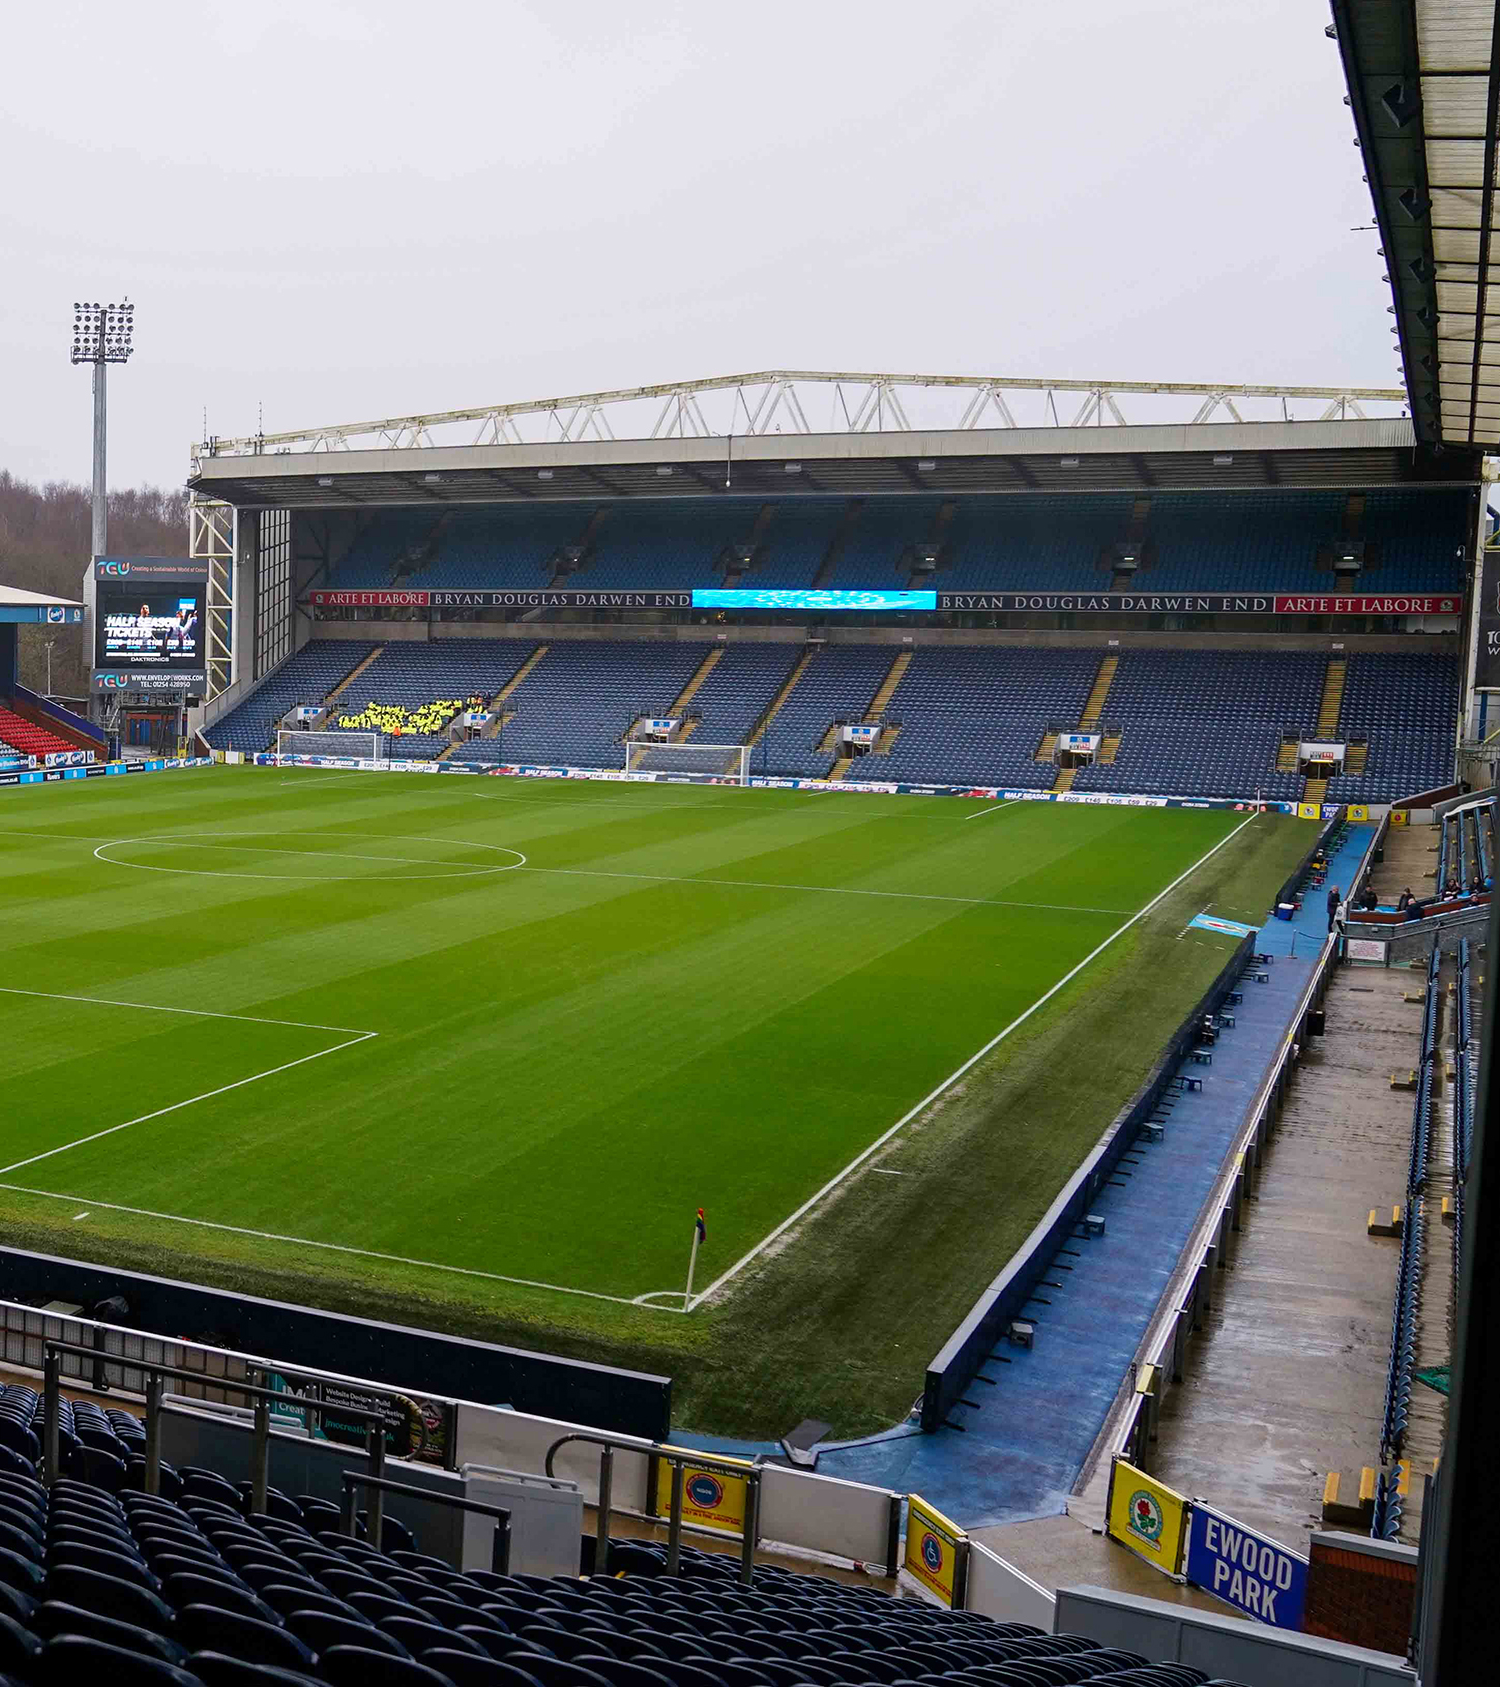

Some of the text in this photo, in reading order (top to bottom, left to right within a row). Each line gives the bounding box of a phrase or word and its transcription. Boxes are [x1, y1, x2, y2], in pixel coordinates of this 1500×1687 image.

[329, 592, 425, 605] ARTE ET LABORE
[435, 594, 690, 607] BRYAN DOUGLAS DARWEN END
[942, 596, 1268, 612] BRYAN DOUGLAS DARWEN END
[1283, 598, 1434, 612] ARTE ET LABORE
[106, 616, 181, 628] HALF SEASON
[107, 628, 153, 638] TICKETS
[766, 780, 793, 788] SEASON
[1023, 792, 1052, 800] SEASON
[326, 1387, 368, 1404] Website Design
[326, 1396, 350, 1407] Bespoke
[1205, 1517, 1292, 1591] EWOOD
[1214, 1558, 1278, 1623] PARK
